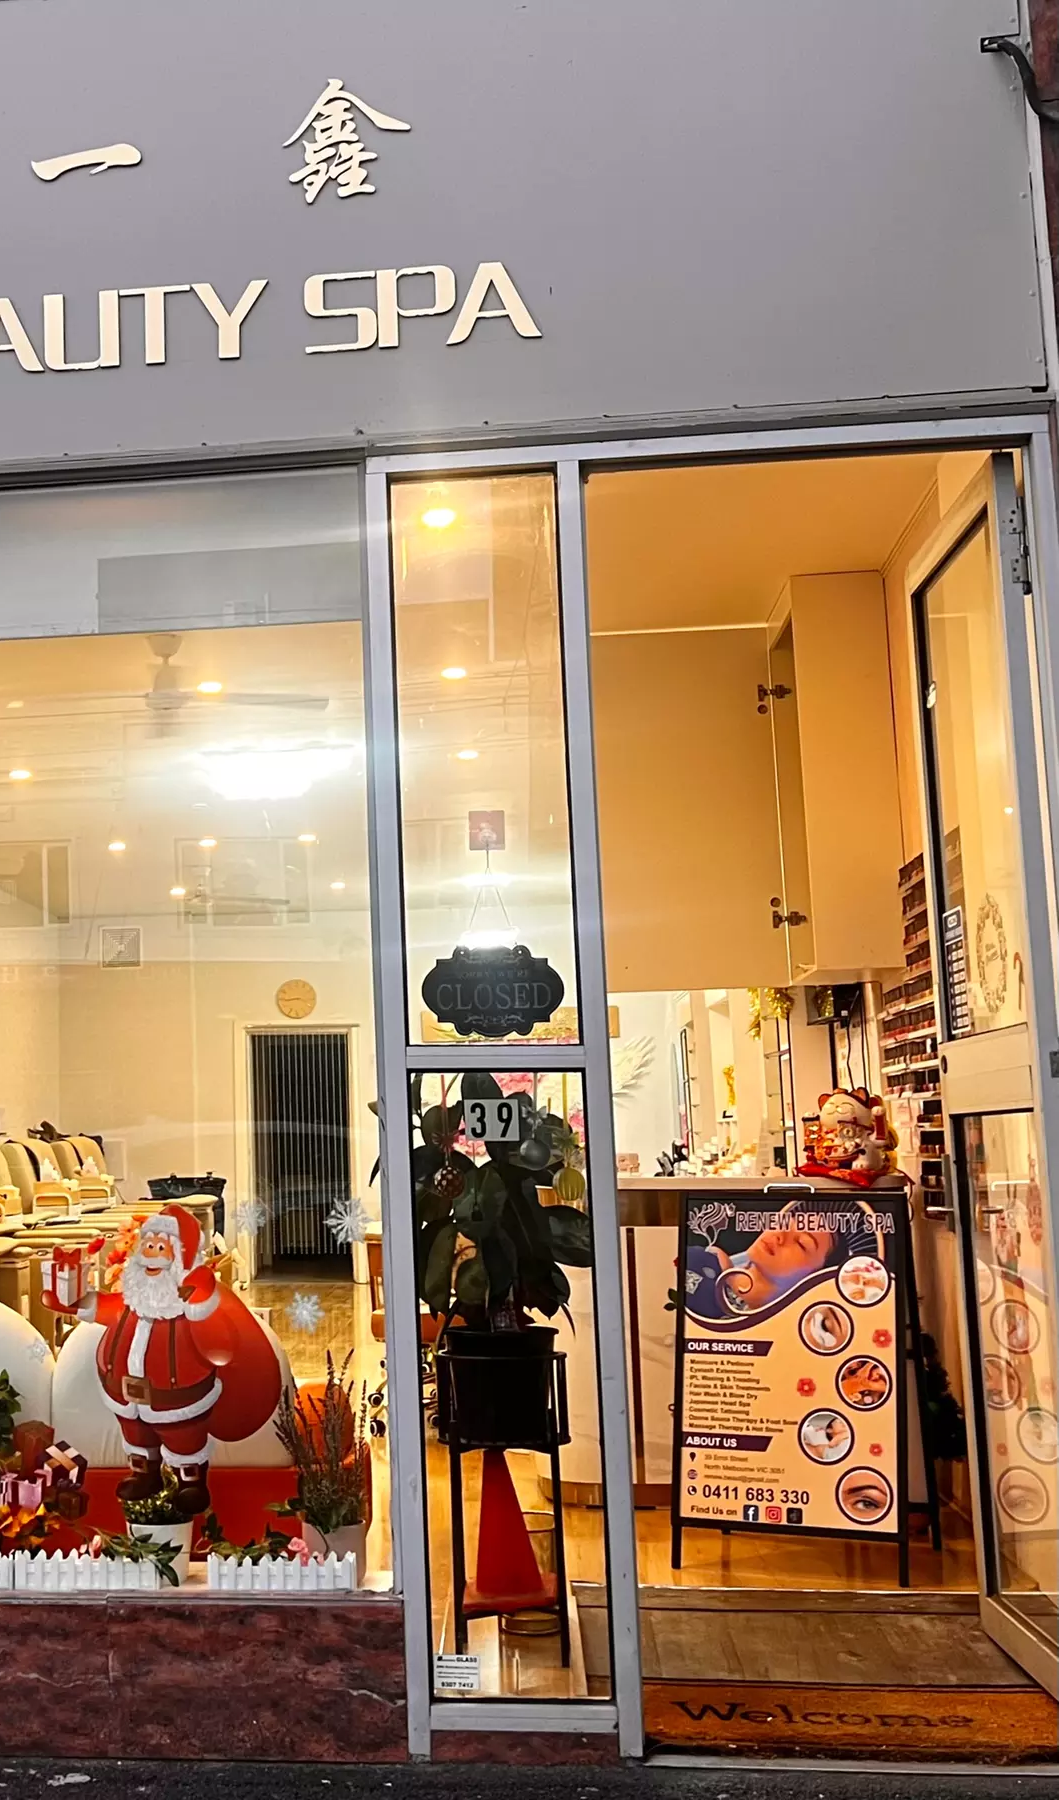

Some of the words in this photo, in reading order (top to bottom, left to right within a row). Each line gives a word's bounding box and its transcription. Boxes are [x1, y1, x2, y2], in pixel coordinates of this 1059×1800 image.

[303, 261, 542, 354] SPA
[436, 982, 552, 1010] CLOSED
[469, 1102, 513, 1139] 39
[735, 1211, 791, 1232] RENEW
[796, 1212, 859, 1233] BEAUTY
[863, 1213, 895, 1234] SPA
[687, 1341, 710, 1351] OUR
[711, 1342, 754, 1353] SERVICE
[686, 1436, 721, 1447] ABOUT
[723, 1438, 738, 1448] US
[703, 1484, 739, 1500] 0411
[745, 1487, 775, 1502] 683
[779, 1489, 810, 1505] 330
[690, 1505, 710, 1514] Find
[712, 1506, 724, 1515] Us
[726, 1508, 737, 1516] on
[671, 1701, 975, 1728] Welcome
